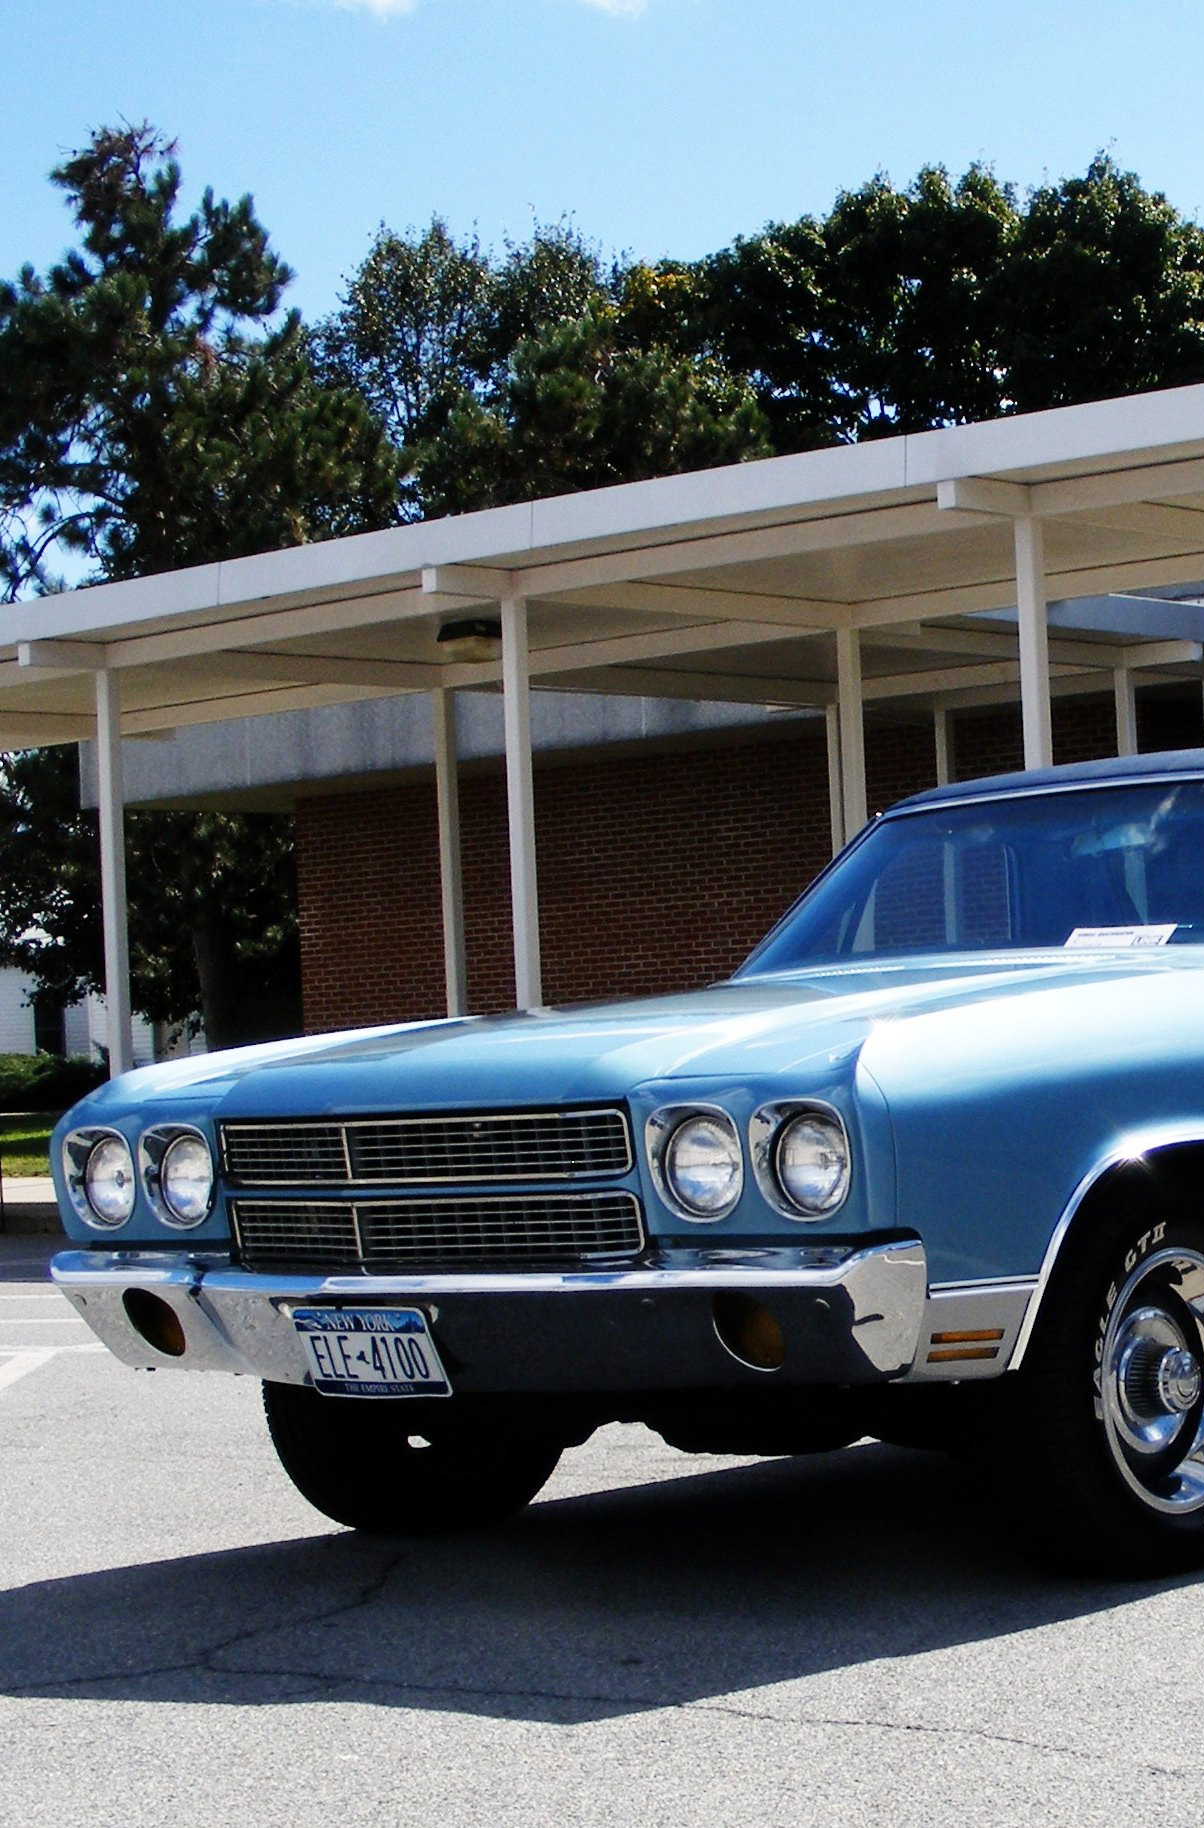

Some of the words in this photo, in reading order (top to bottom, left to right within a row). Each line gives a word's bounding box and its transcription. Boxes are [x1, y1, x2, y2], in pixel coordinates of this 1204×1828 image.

[324, 1314, 354, 1331] NEW
[355, 1314, 396, 1332] YORK
[310, 1335, 359, 1379] ELE
[371, 1335, 430, 1379] 4100
